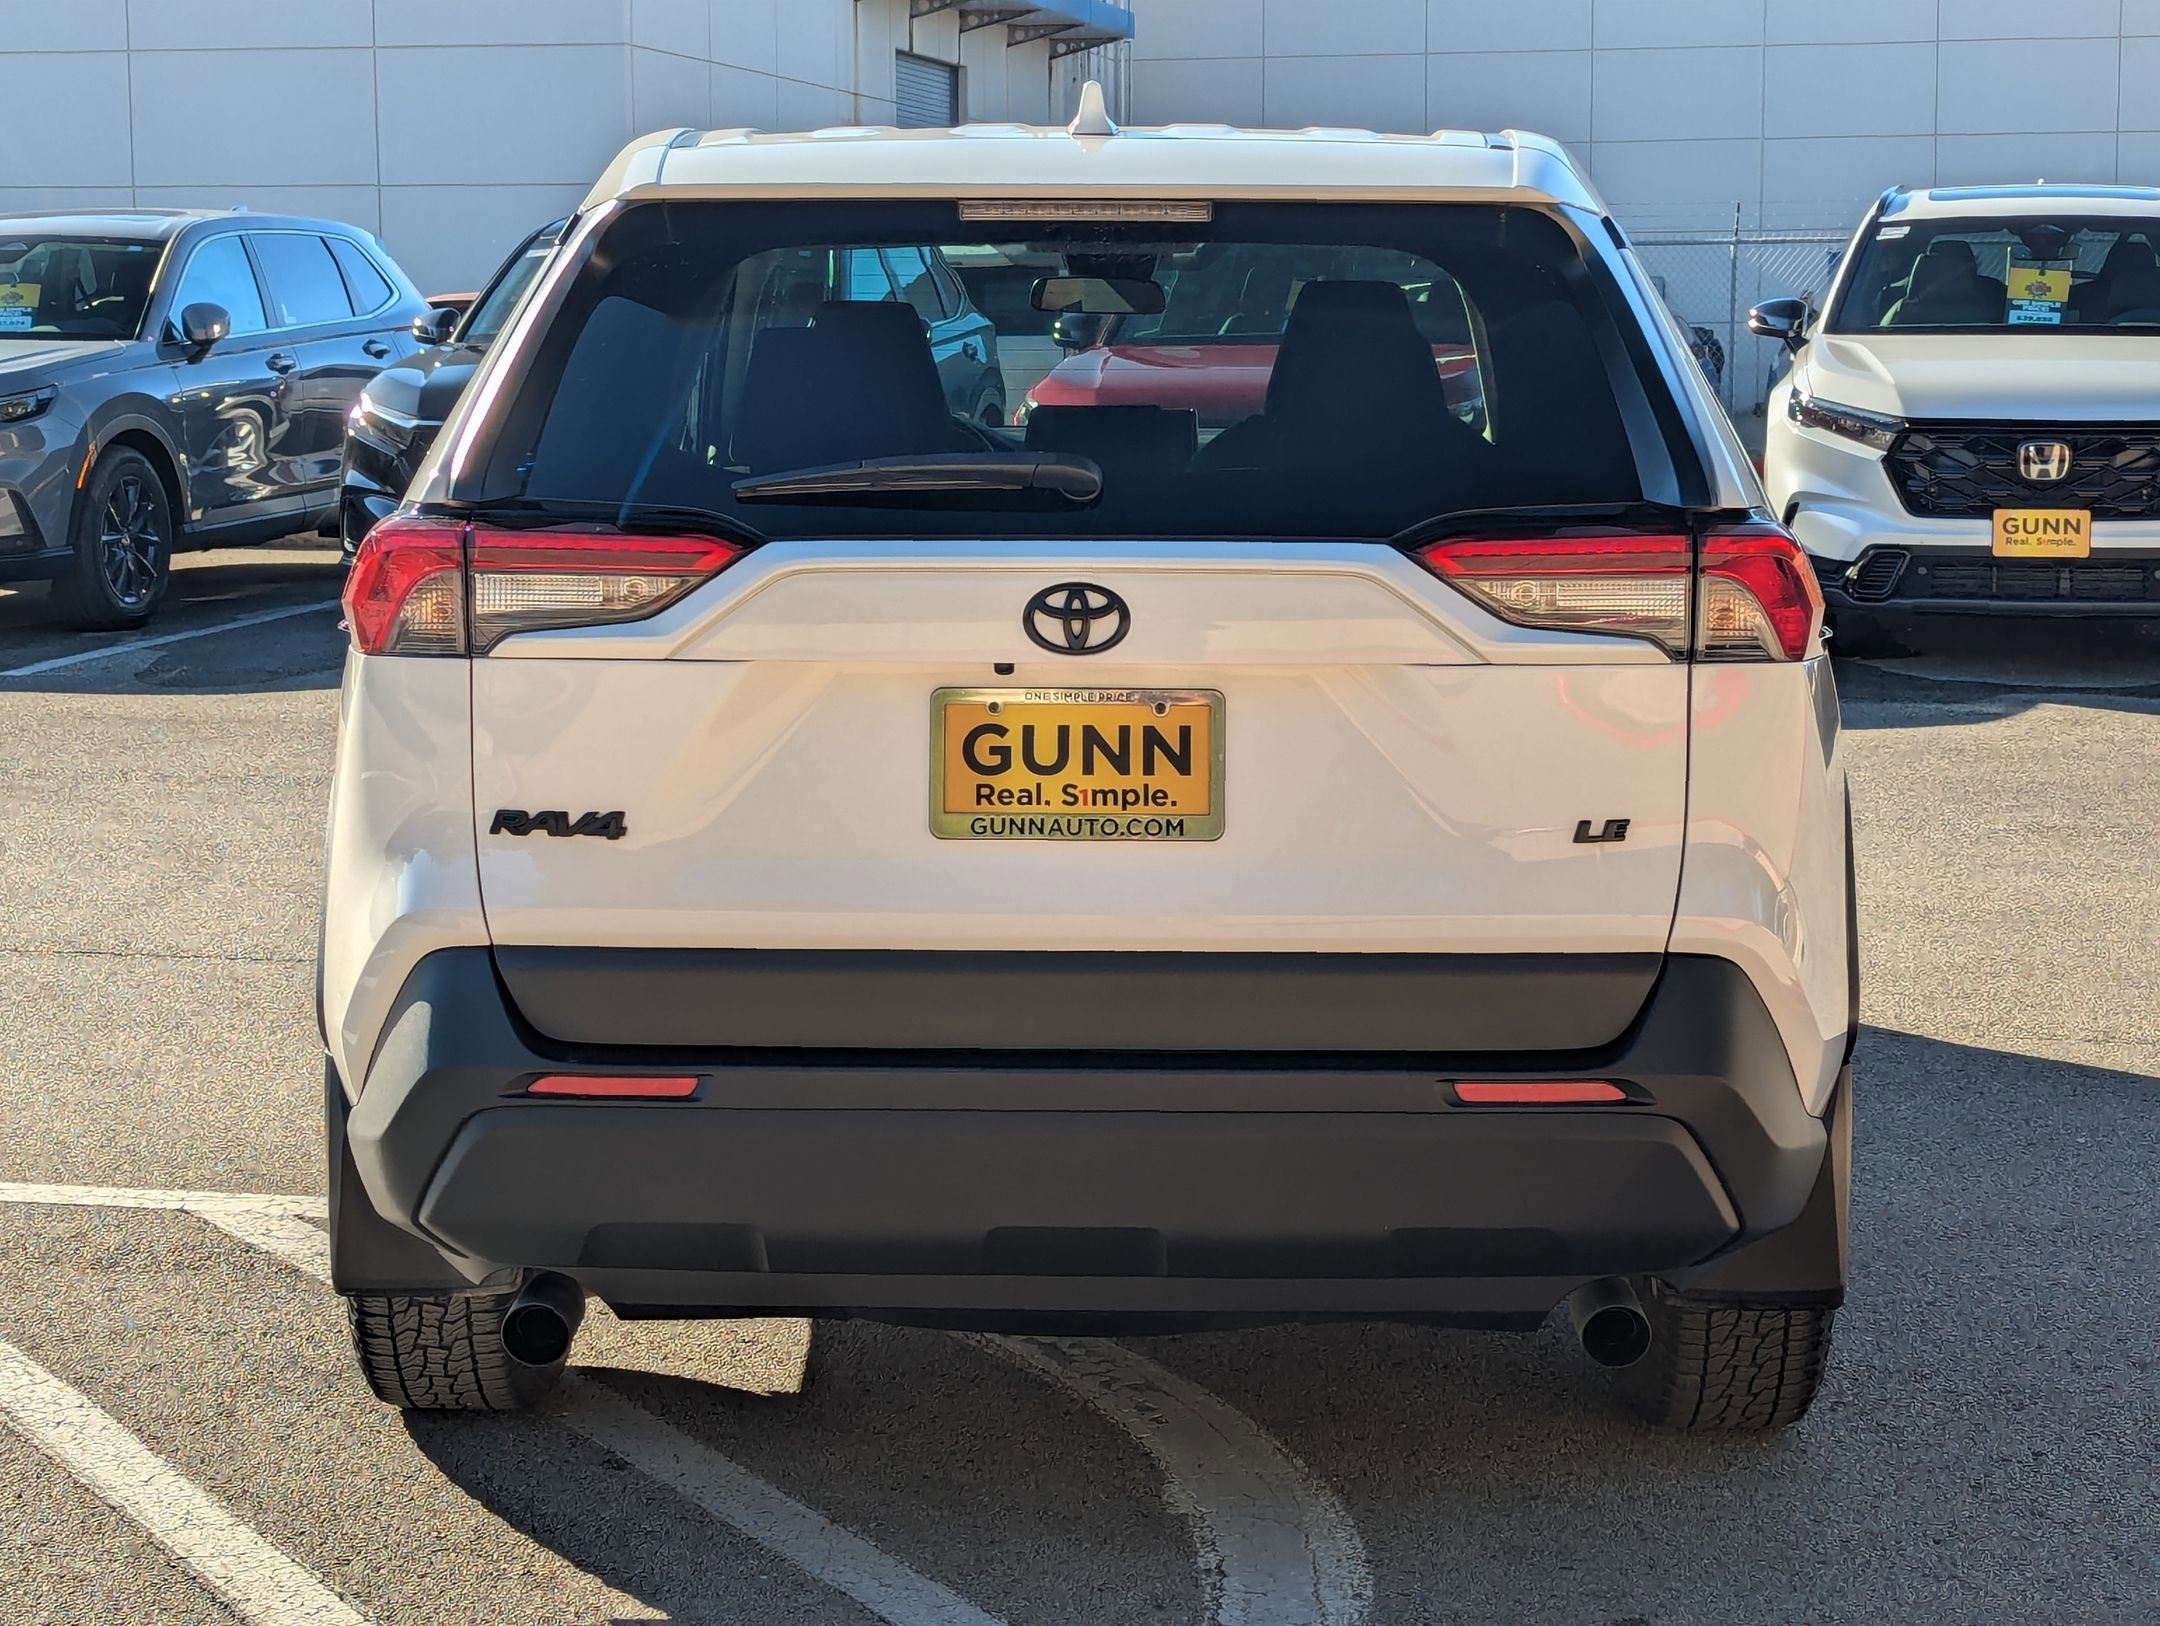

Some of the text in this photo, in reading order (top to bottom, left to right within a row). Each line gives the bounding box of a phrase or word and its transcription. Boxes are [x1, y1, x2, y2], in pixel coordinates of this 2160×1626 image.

[2002, 517, 2081, 535] GUNN
[2005, 536, 2032, 546] Real.
[1024, 691, 1134, 703] ONE SIMPLE PRICE
[962, 723, 1192, 777] GUNN
[975, 783, 1051, 807] Real.
[489, 809, 628, 840] RAV4
[970, 817, 1185, 838] GUNNAUTO.COM
[1572, 818, 1631, 843] LE
